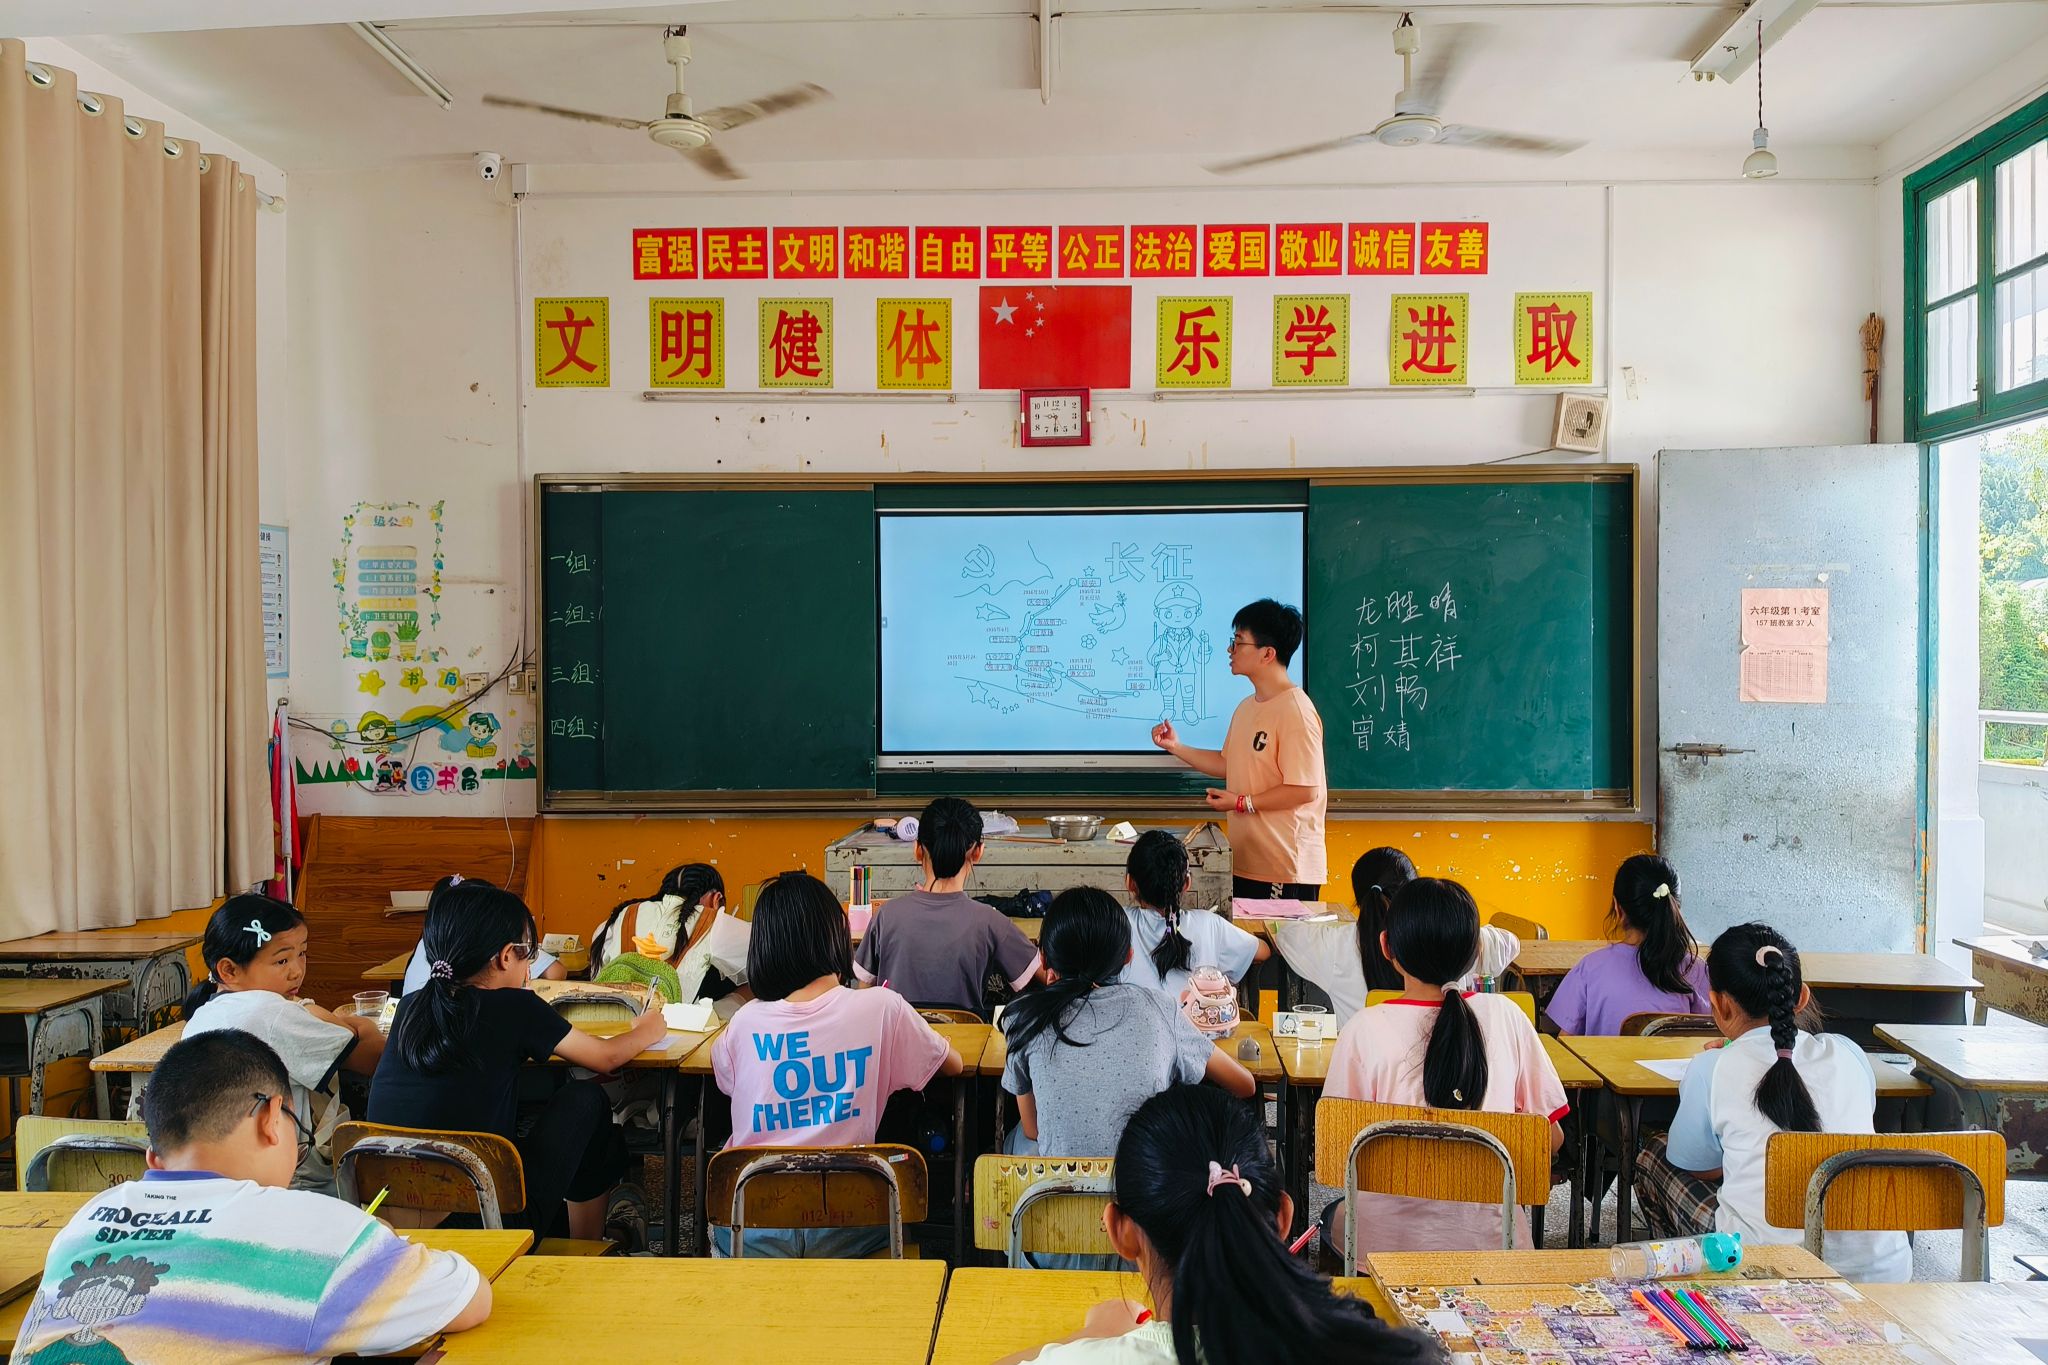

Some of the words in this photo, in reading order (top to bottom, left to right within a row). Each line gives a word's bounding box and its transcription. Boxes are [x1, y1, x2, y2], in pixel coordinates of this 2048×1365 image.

[638, 236, 693, 274] 富强
[708, 235, 763, 273] 民主
[779, 234, 834, 273] 文明
[849, 233, 905, 273] 和谐
[922, 234, 974, 273] 自由
[991, 233, 1048, 272] 平等
[1063, 234, 1120, 271] 公正
[1135, 232, 1193, 271] 法治
[1209, 231, 1266, 270] 爱国
[1280, 231, 1339, 269] 敬业
[1353, 230, 1411, 269] 诚信
[1425, 229, 1484, 268] 友善
[545, 306, 598, 376] 文
[660, 310, 713, 378] 明
[769, 309, 823, 378] 健
[887, 309, 942, 380] 体
[1167, 305, 1220, 376] 乐
[1284, 305, 1337, 376] 学
[1402, 304, 1457, 375] 进
[1526, 303, 1581, 373] 取
[1104, 542, 1194, 583] 长征
[1350, 632, 1463, 673] 柯其祥
[1345, 671, 1428, 719] 刘畅
[1353, 714, 1411, 752] 曾婧
[410, 765, 480, 792] 图书角
[752, 1030, 812, 1061] WE
[773, 1045, 873, 1100] OUT
[752, 1091, 861, 1133] THERE.
